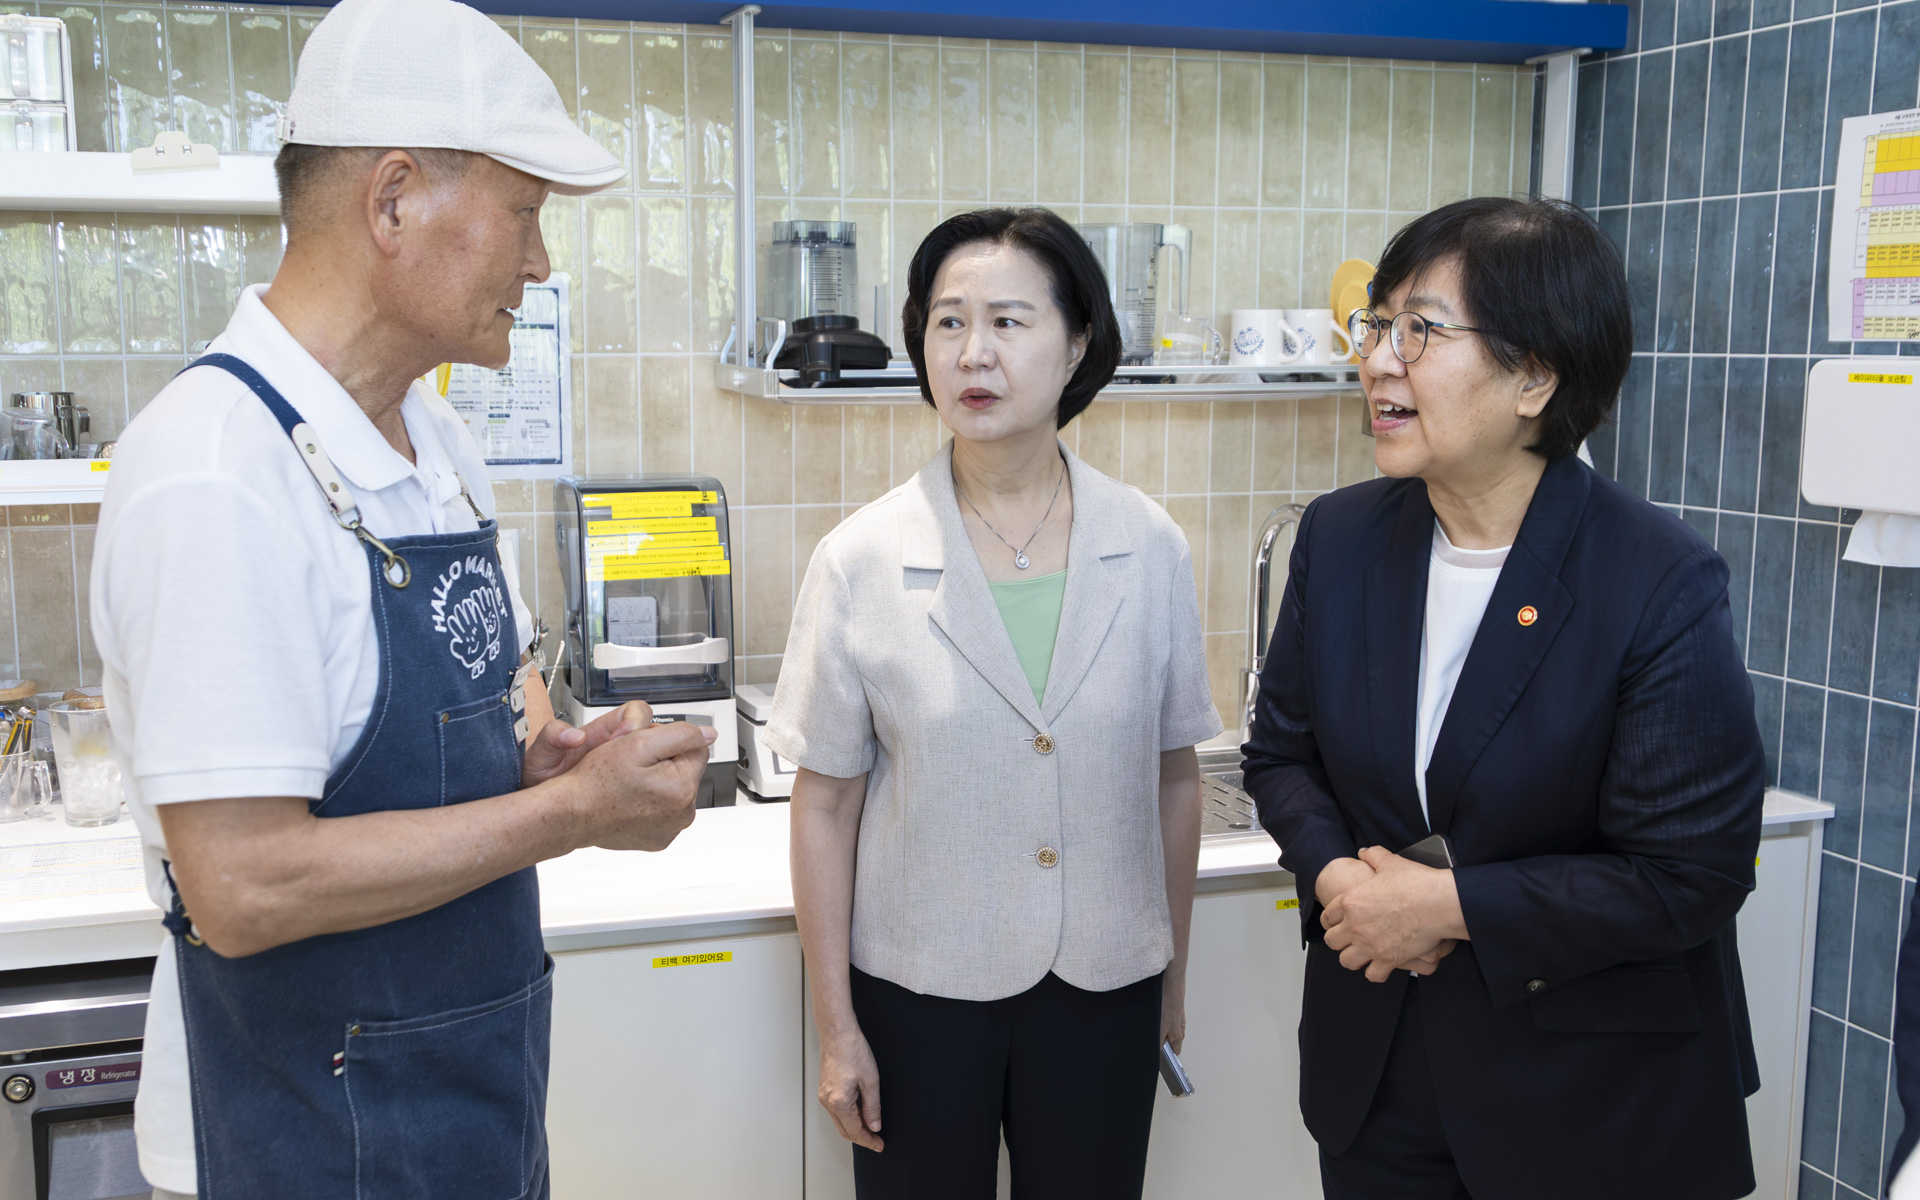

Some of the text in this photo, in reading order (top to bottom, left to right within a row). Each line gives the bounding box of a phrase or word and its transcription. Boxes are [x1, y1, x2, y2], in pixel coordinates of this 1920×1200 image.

[431, 560, 462, 633] HALLO
[1284, 899, 1300, 908] 세탁
[661, 952, 724, 966] 티백 여기있어요
[101, 1070, 137, 1080] Refrigerator
